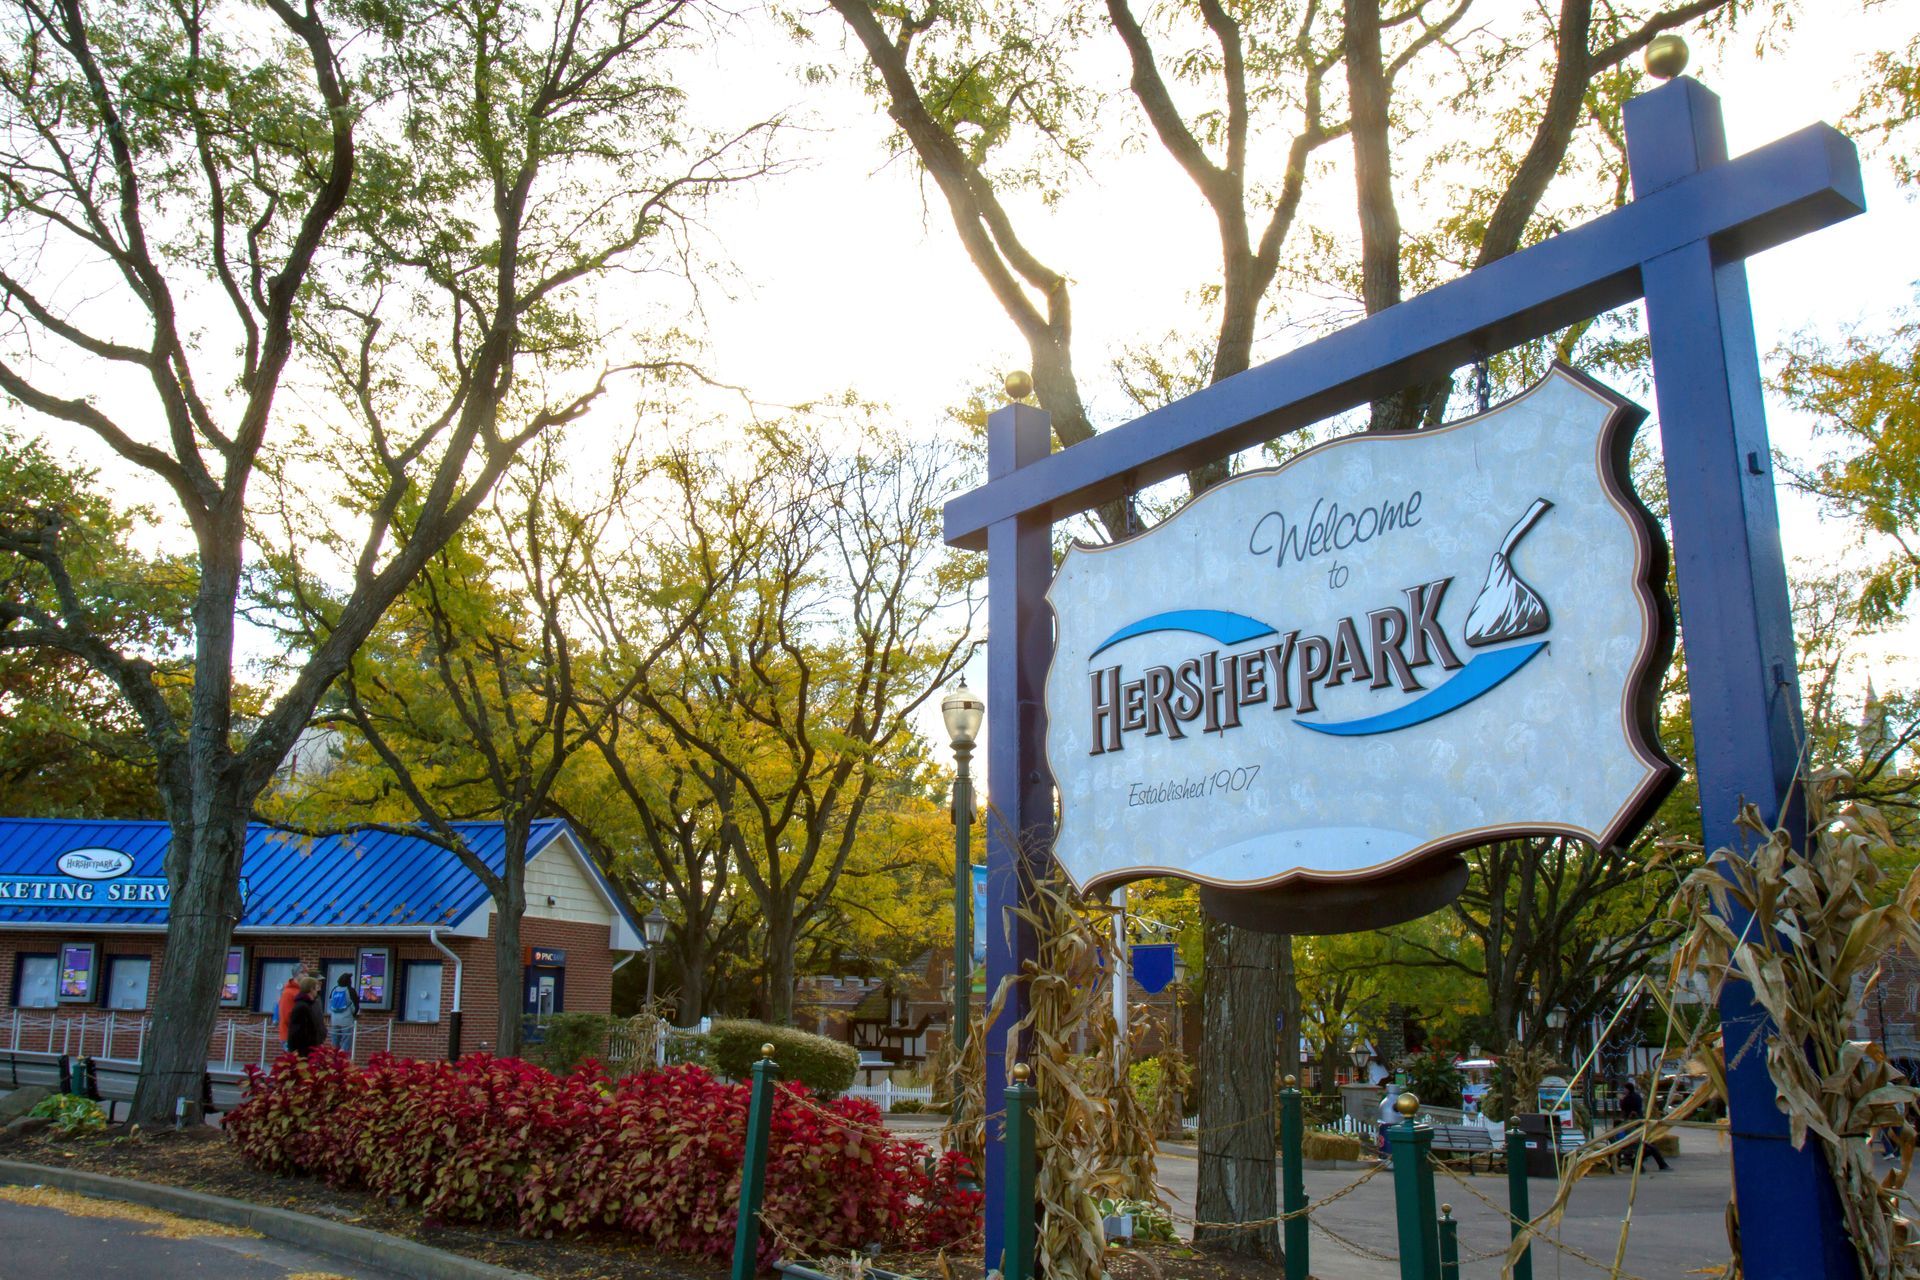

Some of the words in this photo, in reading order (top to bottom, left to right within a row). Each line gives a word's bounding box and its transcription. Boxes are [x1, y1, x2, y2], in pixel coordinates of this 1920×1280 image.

[1249, 490, 1422, 569] Welcome
[1328, 560, 1349, 590] to
[1088, 576, 1464, 756] HERSHEYPARK
[1129, 776, 1206, 807] Established
[1210, 765, 1261, 795] 1907
[541, 952, 553, 961] PNC
